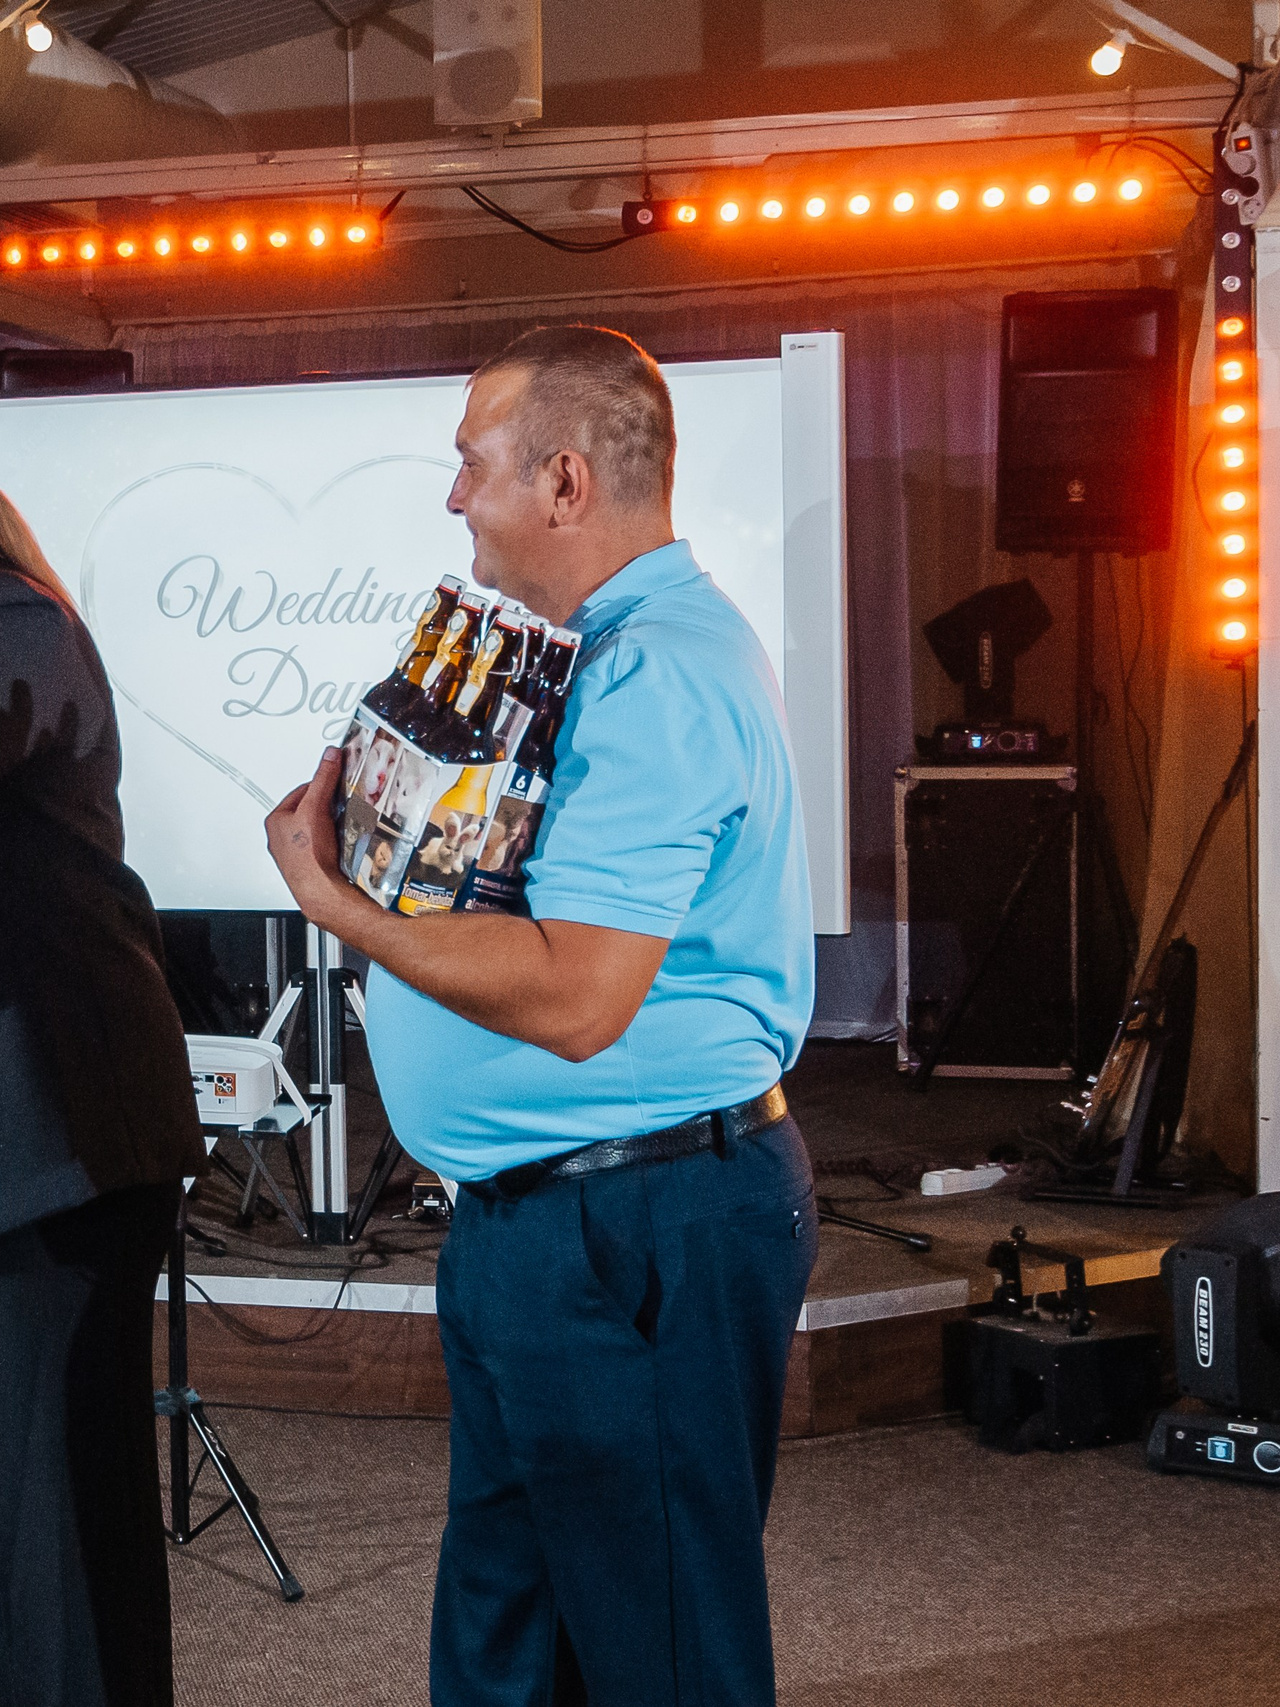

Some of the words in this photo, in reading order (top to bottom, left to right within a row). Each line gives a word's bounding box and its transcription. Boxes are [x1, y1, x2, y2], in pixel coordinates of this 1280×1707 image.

[157, 555, 434, 651] Wedding
[222, 645, 372, 740] Day
[515, 775, 526, 789] 6
[1199, 1288, 1209, 1329] BEAM
